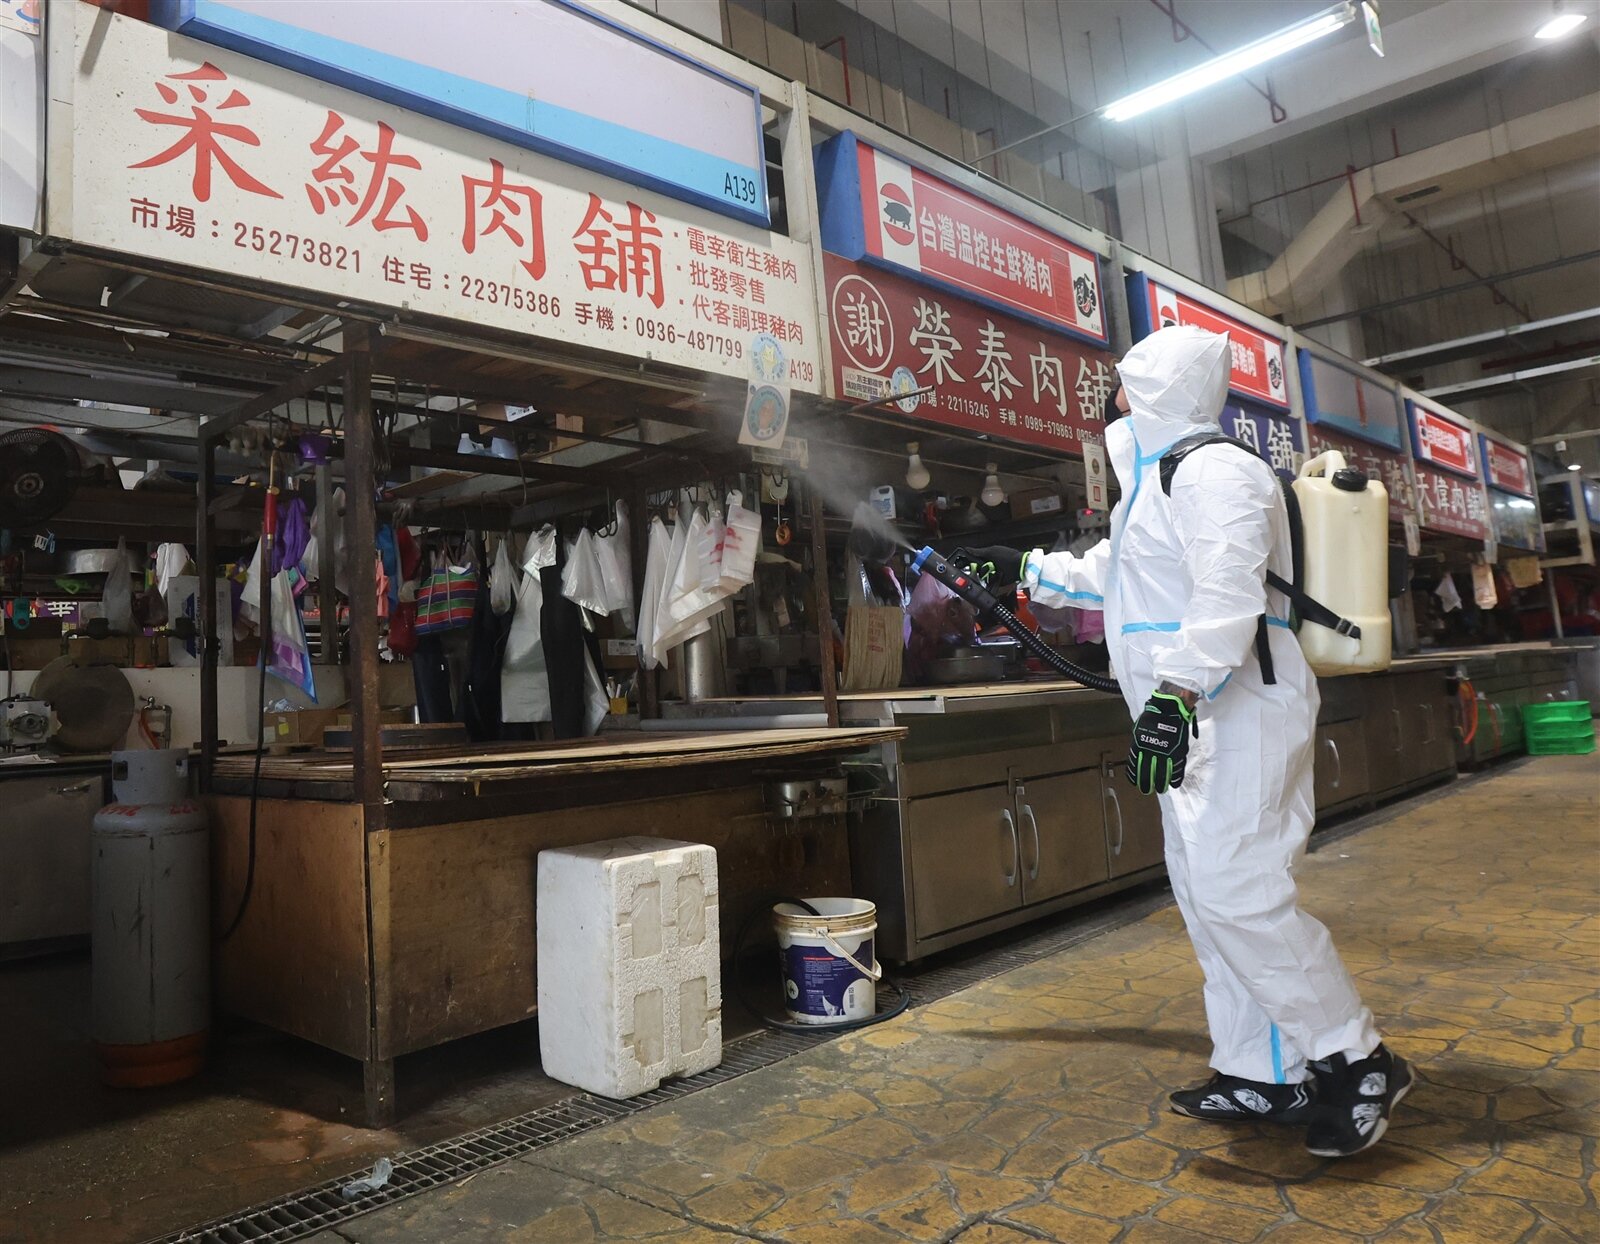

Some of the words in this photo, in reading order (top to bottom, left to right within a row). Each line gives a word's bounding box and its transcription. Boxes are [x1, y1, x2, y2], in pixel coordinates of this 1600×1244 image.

[127, 61, 665, 310] 采紘肉舖
[723, 172, 757, 205] A139
[686, 226, 799, 285] 電宰衛生豬肉
[689, 259, 767, 306] 批發零售
[691, 294, 804, 346] 代客調理豬肉
[841, 291, 885, 358] 謝
[790, 358, 813, 383] A139
[908, 296, 1112, 422] 榮泰肉舖
[1140, 734, 1170, 749] SPORTS
